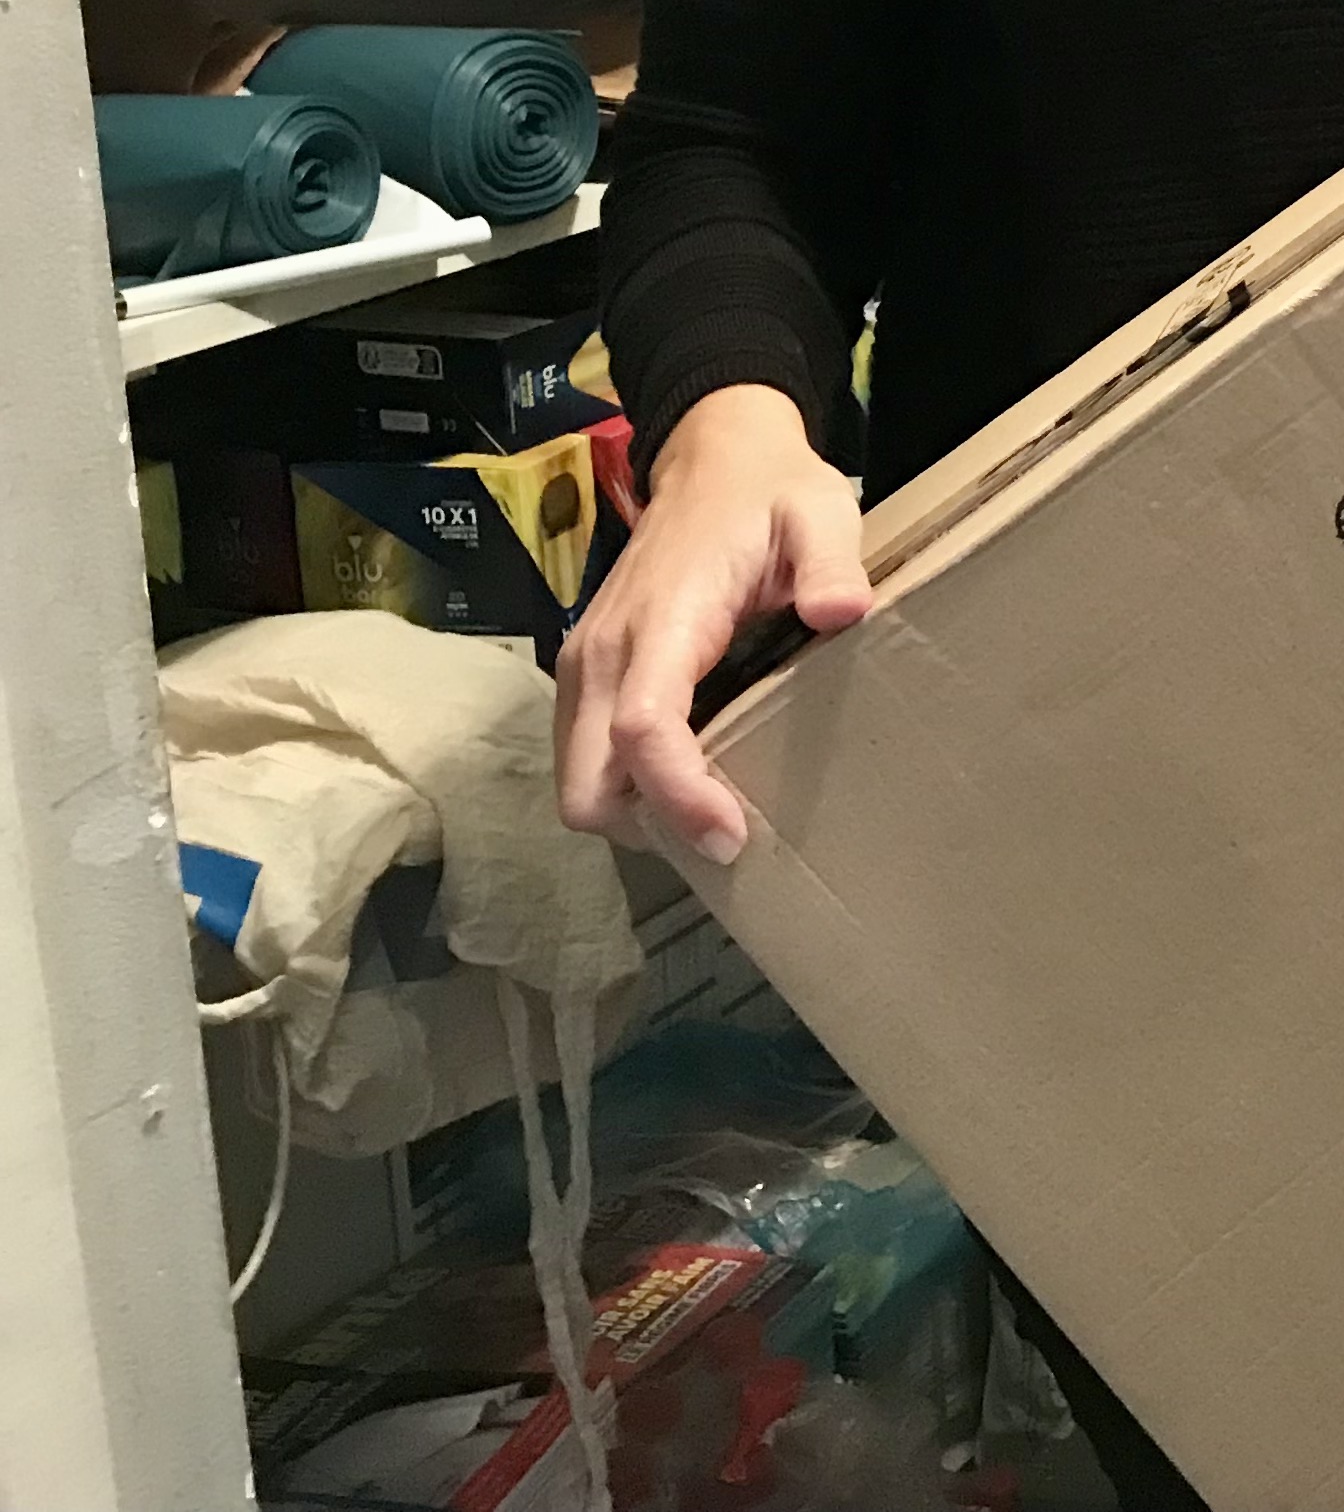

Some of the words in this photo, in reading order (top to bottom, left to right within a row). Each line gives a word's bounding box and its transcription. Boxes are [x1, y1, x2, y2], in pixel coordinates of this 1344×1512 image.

[543, 365, 559, 399] blu
[421, 506, 446, 525] 10
[450, 506, 465, 525] X
[467, 508, 478, 525] 1
[332, 554, 384, 583] blu
[607, 1294, 671, 1342] AVOIR
